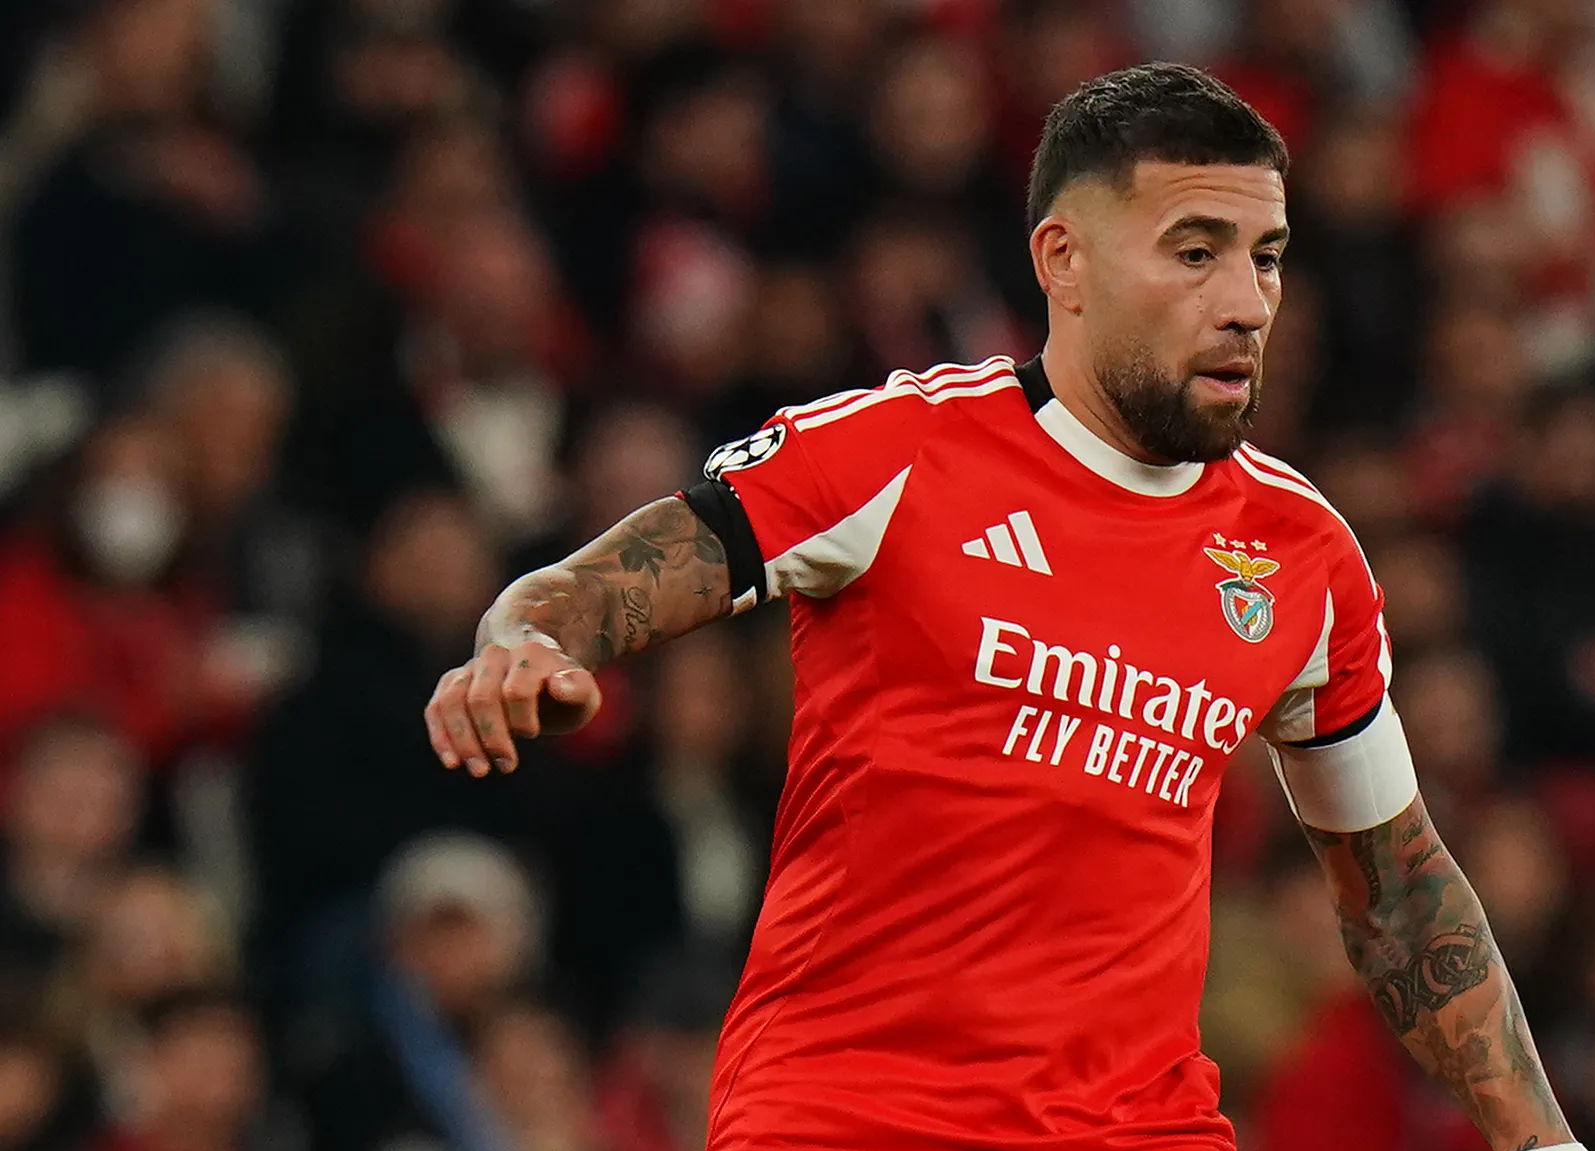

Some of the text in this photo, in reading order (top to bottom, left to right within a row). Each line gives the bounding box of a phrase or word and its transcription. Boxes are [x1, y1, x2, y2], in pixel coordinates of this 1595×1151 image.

[974, 616, 1253, 755] Emirates
[1002, 705, 1204, 808] FLY BETTER
